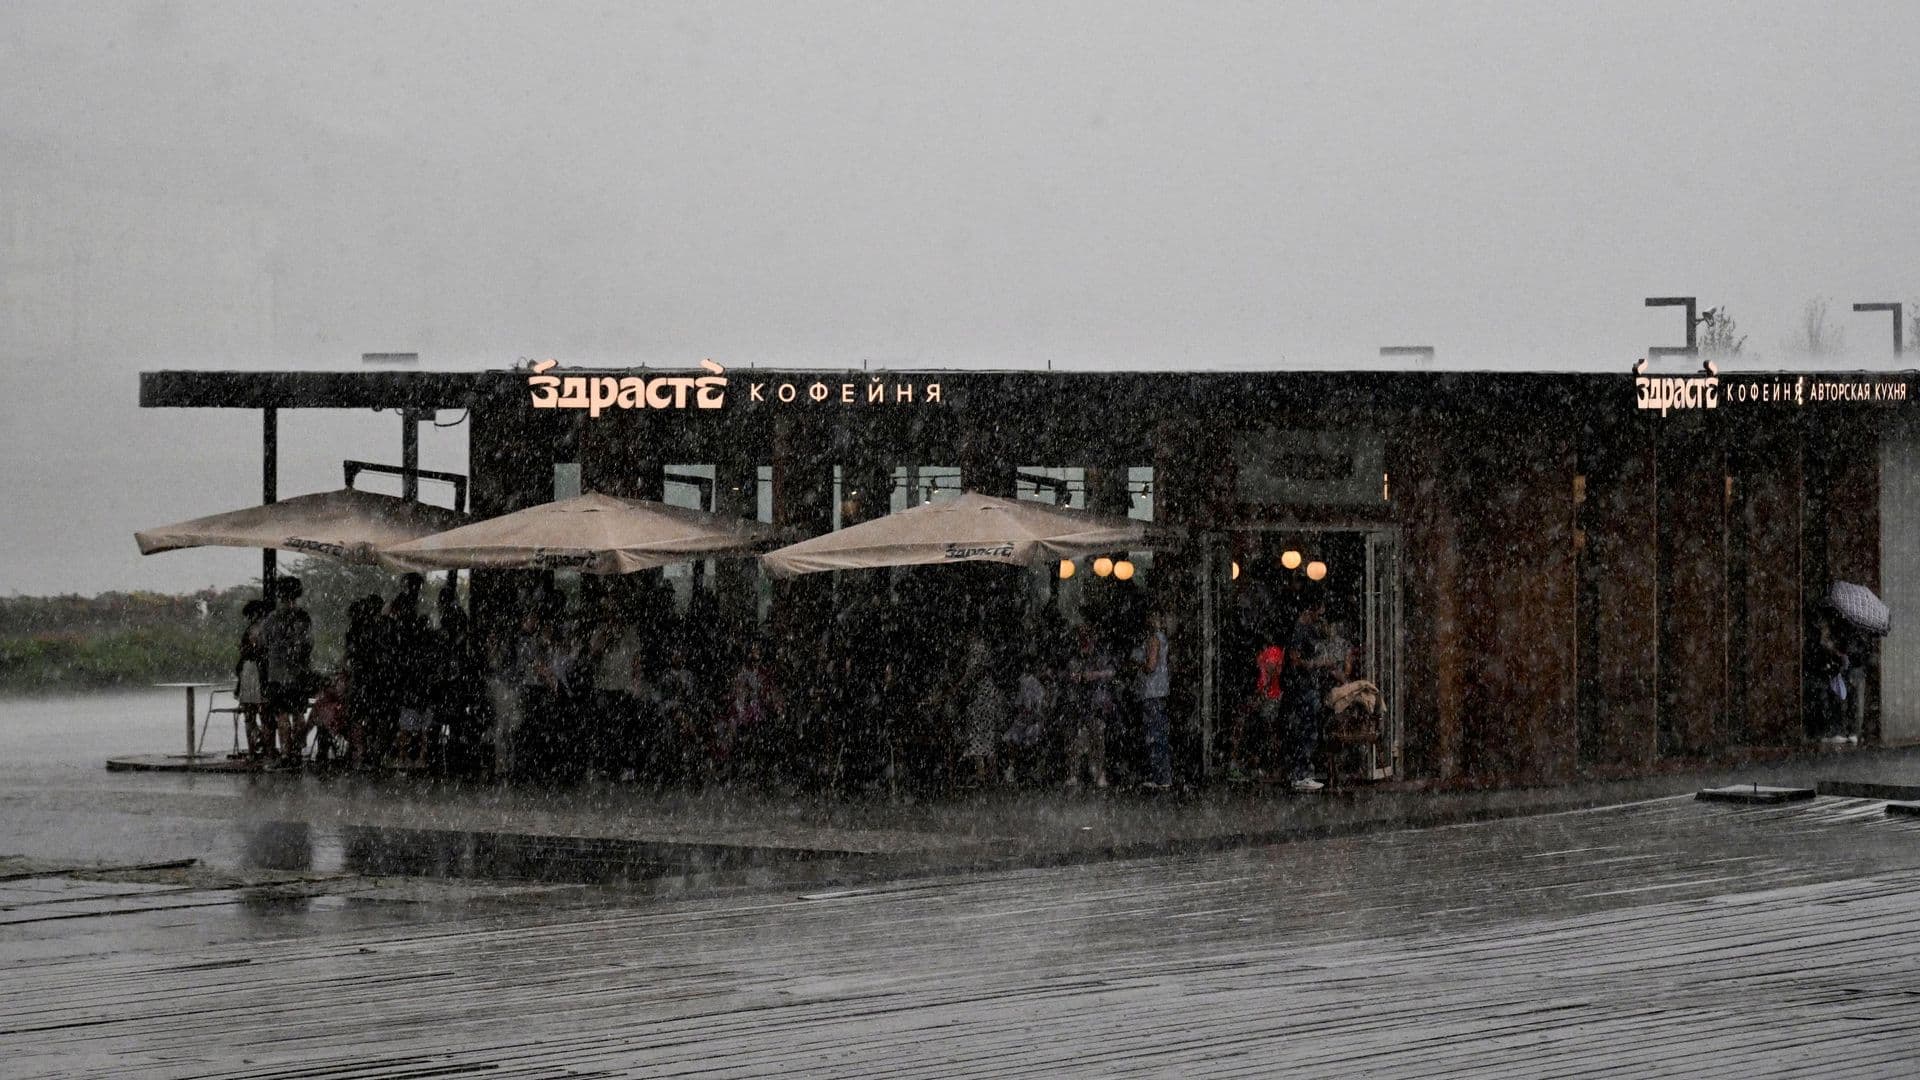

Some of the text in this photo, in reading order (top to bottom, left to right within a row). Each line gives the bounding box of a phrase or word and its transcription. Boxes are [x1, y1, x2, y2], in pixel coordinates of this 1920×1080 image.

[750, 377, 942, 403] КОФЕЙНЯ
[1727, 377, 1801, 402] КОФЕЙНЯ
[1810, 382, 1870, 402] АВТОРСКАЯ
[1875, 382, 1907, 402] КУХНЯ
